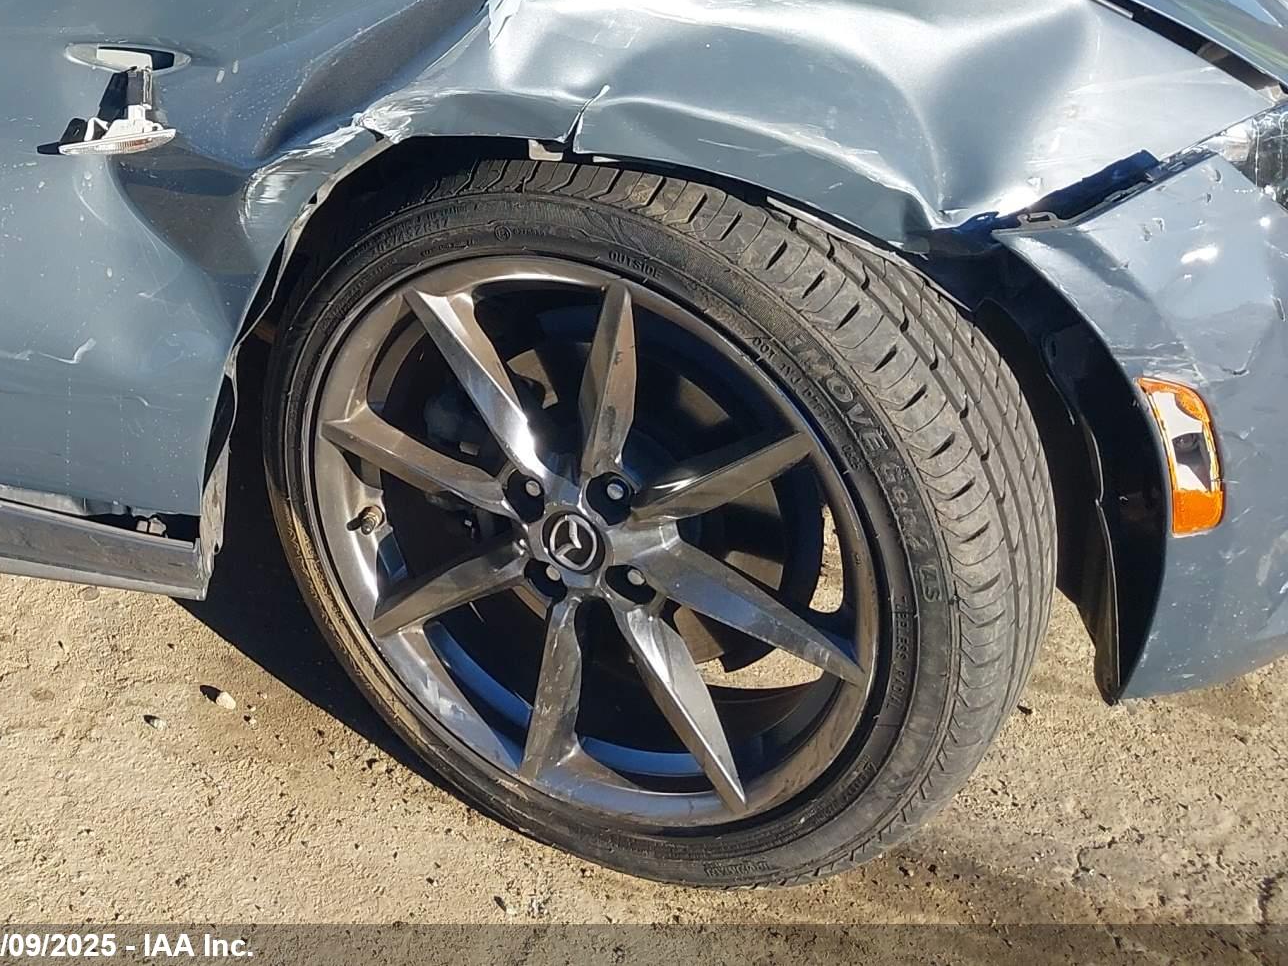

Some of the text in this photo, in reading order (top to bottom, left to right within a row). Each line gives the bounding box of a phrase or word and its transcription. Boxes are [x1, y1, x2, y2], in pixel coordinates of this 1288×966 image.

[608, 251, 664, 280] OUTSIDE
[752, 336, 778, 360] DOT
[886, 666, 906, 709] RADIAL
